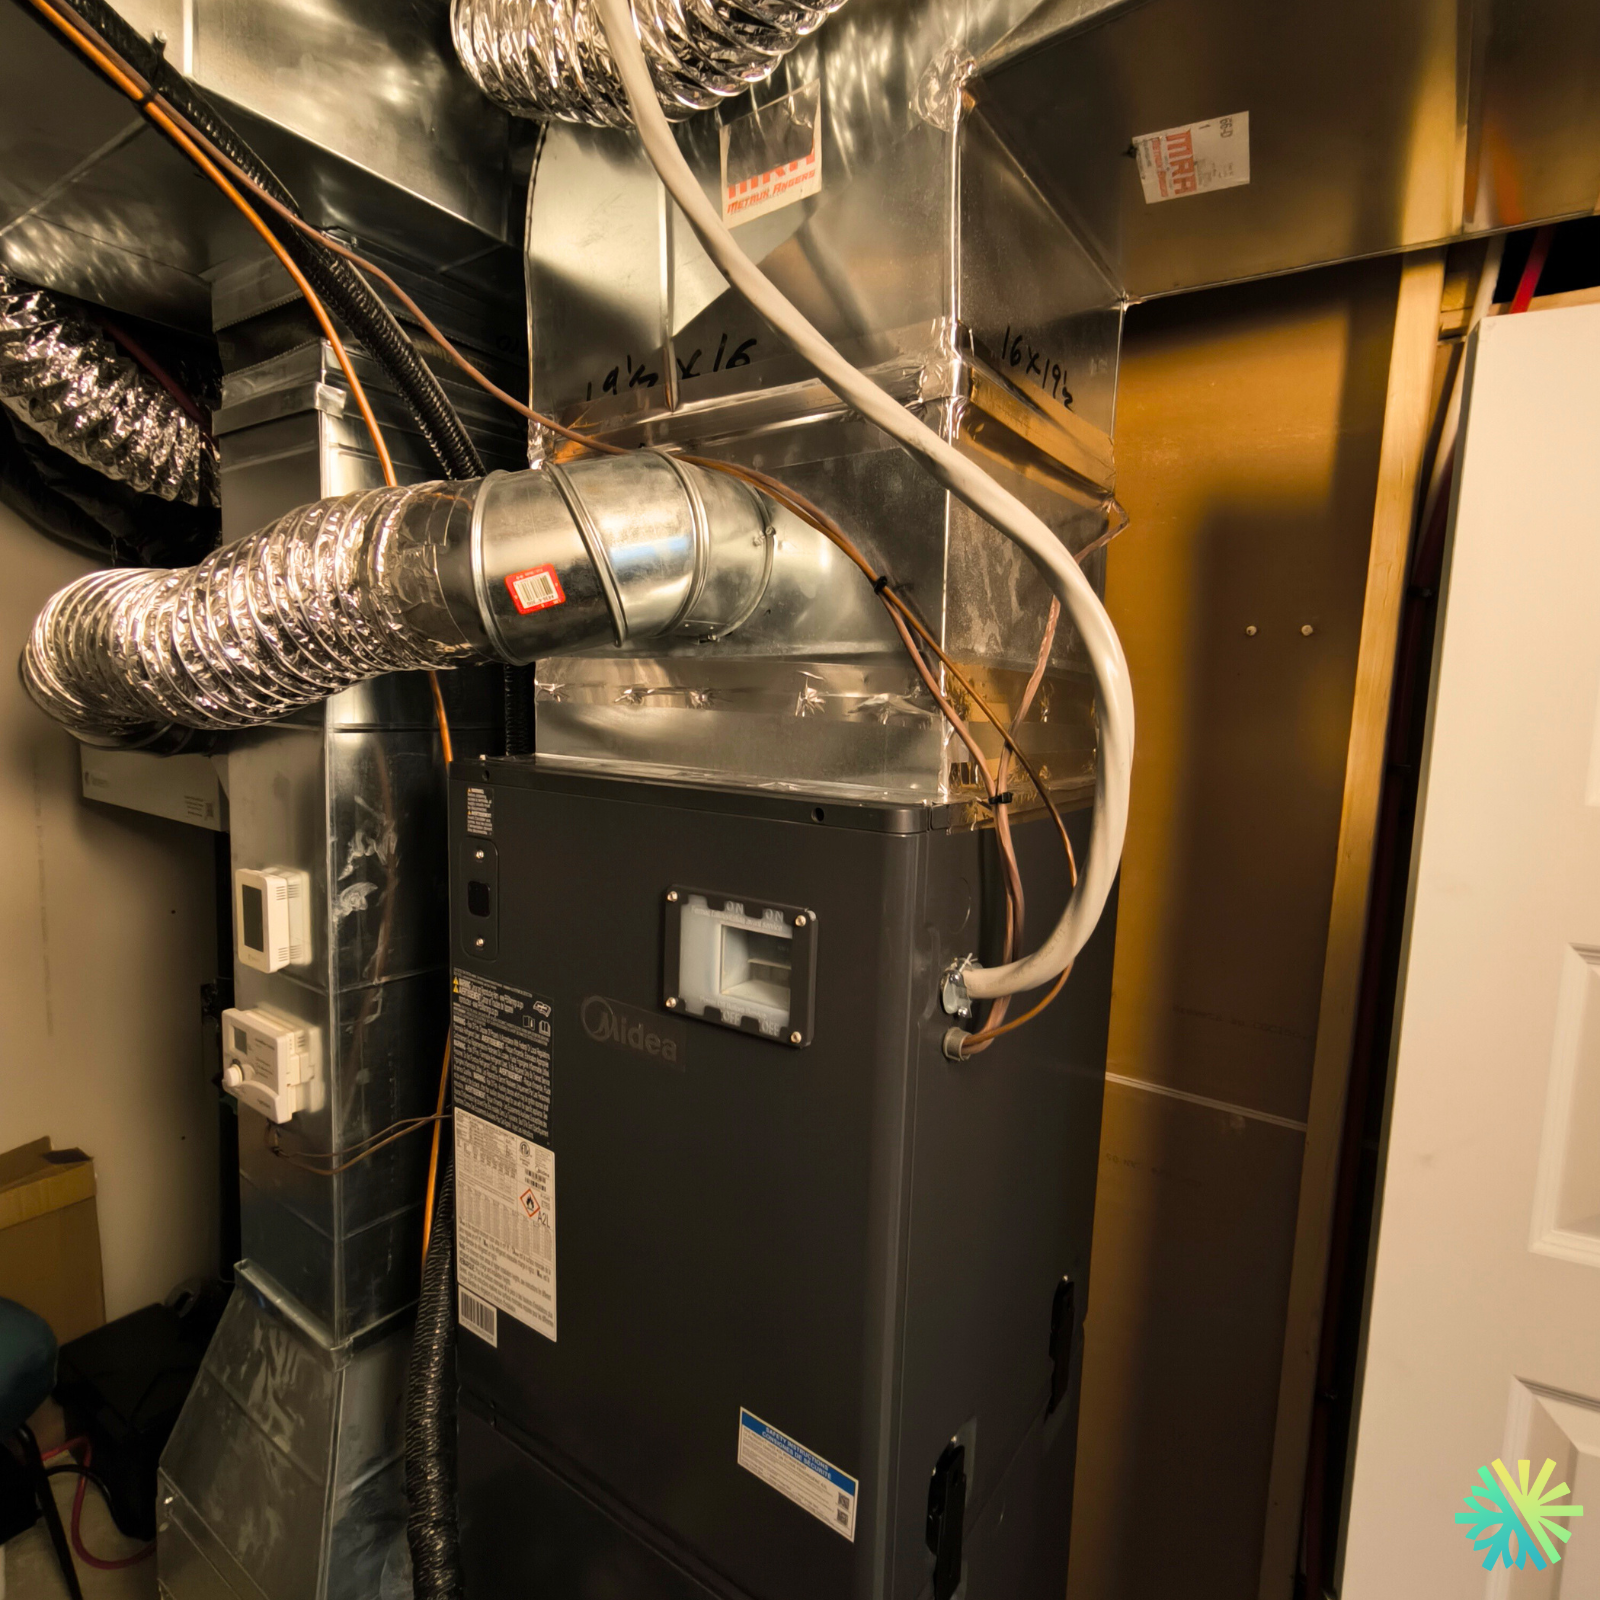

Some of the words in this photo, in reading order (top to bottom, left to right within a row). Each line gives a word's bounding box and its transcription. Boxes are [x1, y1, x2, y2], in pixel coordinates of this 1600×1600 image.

[1165, 127, 1198, 195] MRA
[713, 332, 757, 373] 16
[580, 995, 678, 1063] Midea
[537, 1210, 551, 1229] A2L
[765, 1426, 787, 1444] SAFETY
[787, 1440, 829, 1471] INSTRUCTIONS
[794, 1452, 803, 1462] DE
